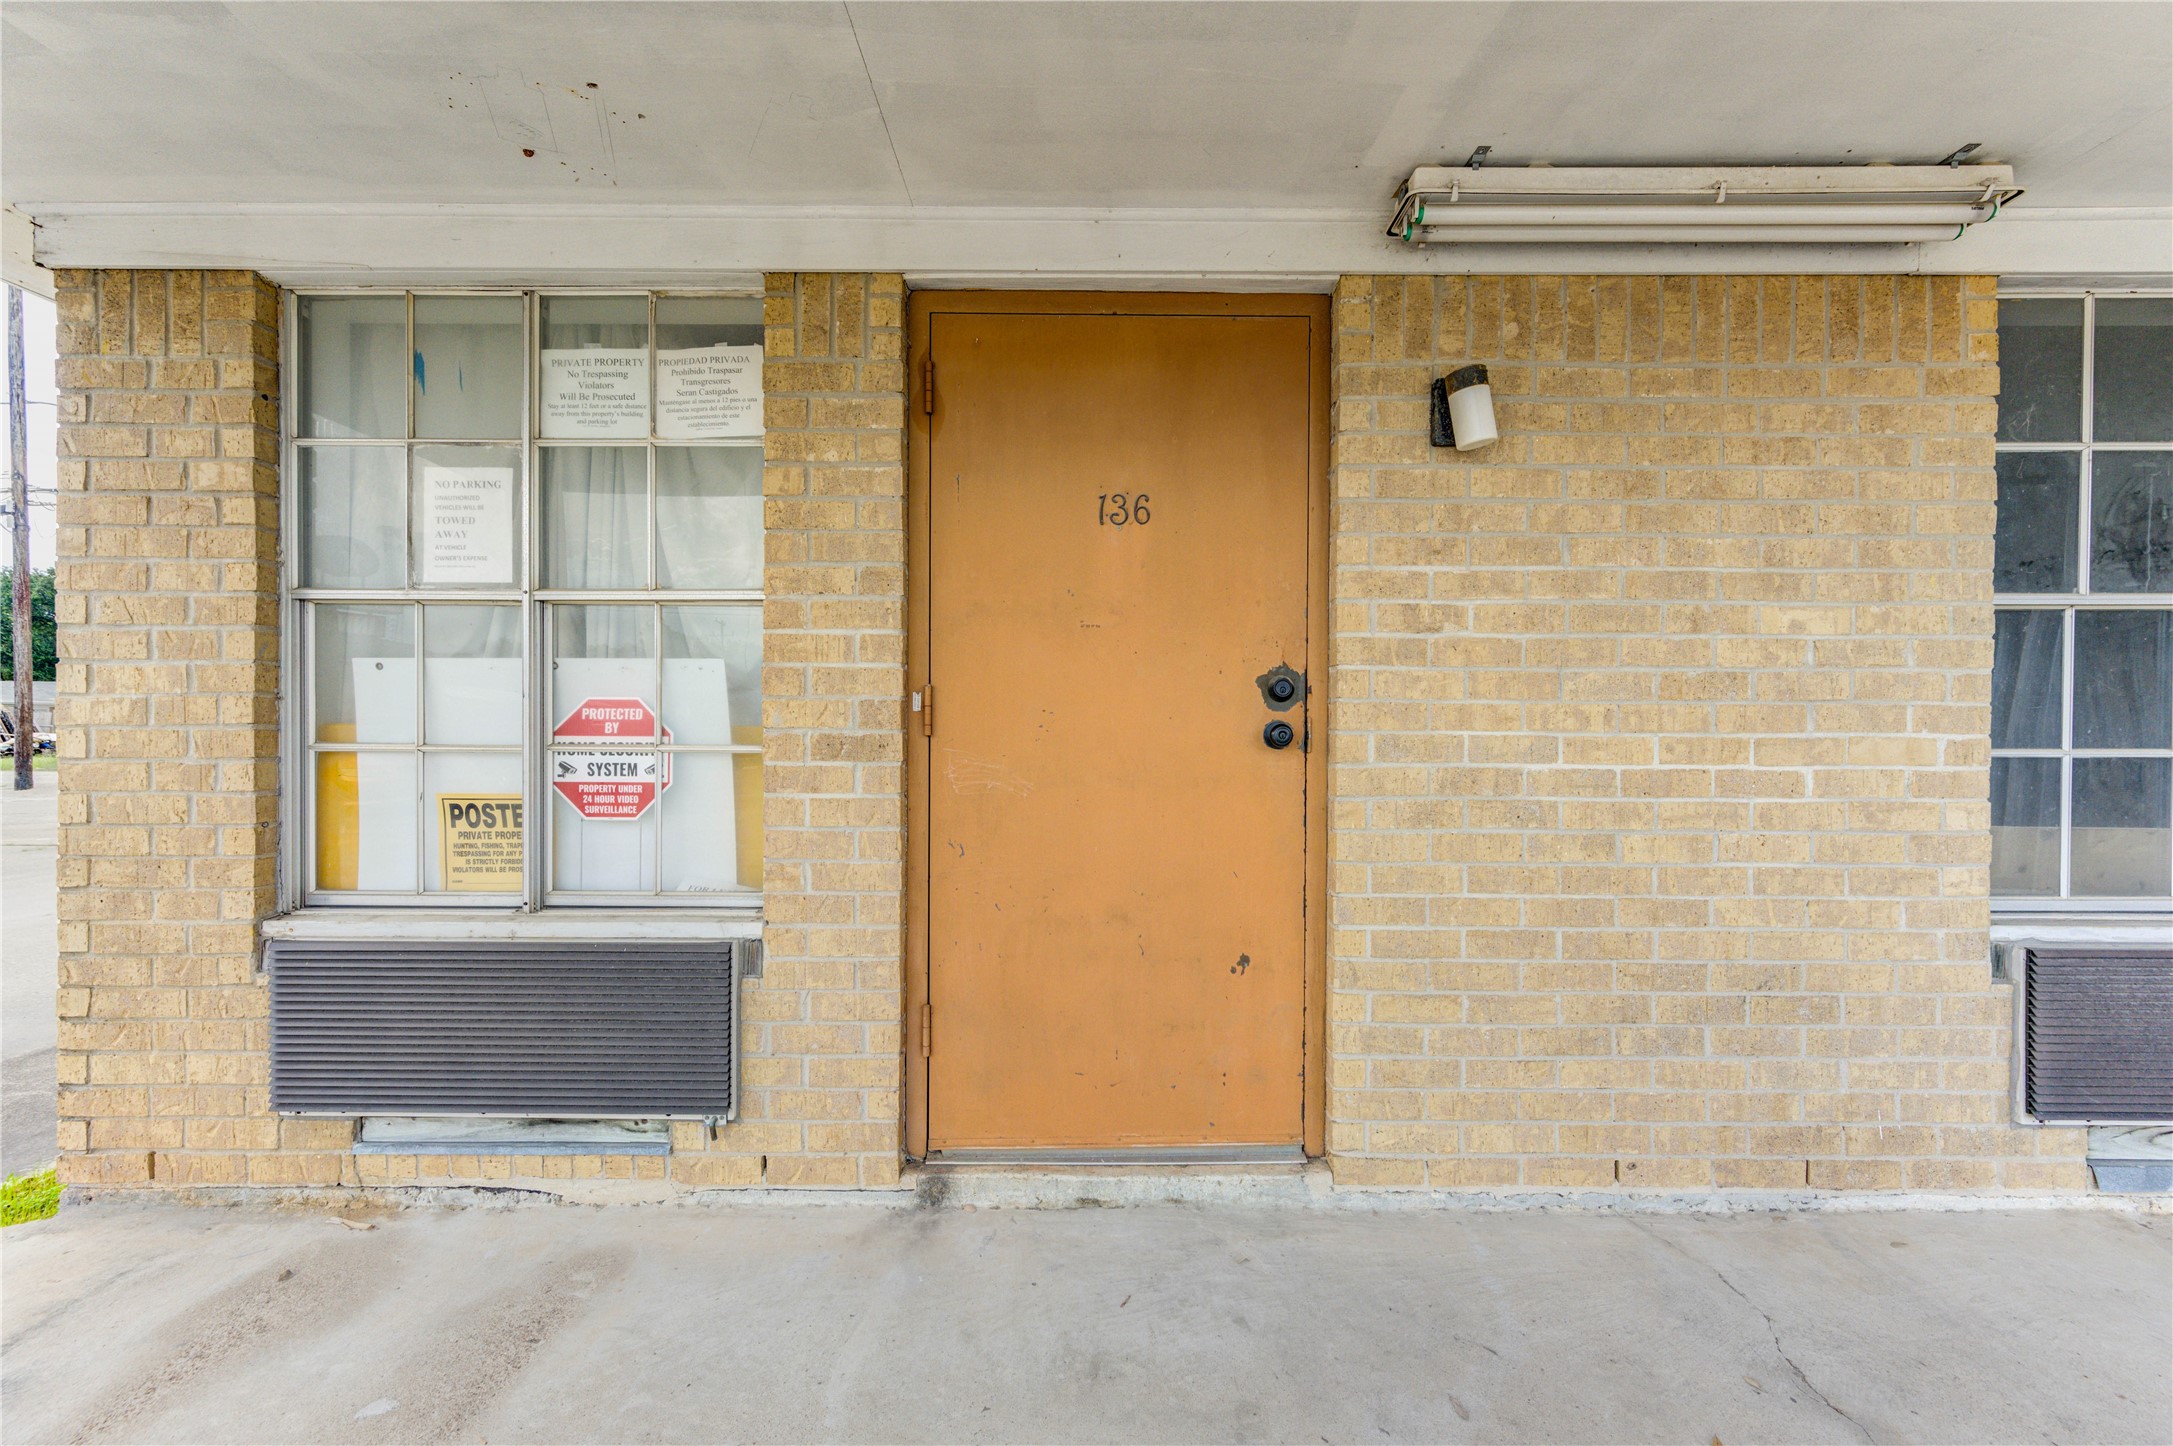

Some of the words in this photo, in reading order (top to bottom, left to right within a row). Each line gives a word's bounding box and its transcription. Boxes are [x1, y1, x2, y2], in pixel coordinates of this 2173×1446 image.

[551, 358, 592, 367] PRIVATE
[594, 358, 645, 367] PROPERTY
[658, 356, 708, 367] PROPIEDAD
[709, 355, 750, 364] PRIVADA
[567, 370, 579, 378] No
[582, 370, 628, 380] Trespassing
[671, 368, 705, 376] Prohibido
[707, 366, 743, 375] Traspasar
[578, 381, 614, 389] Violators
[681, 378, 731, 387] Transgresores
[698, 387, 738, 396] Castigados
[435, 480, 450, 489] NO
[453, 480, 501, 489] PARKING
[1098, 494, 1151, 525] 136
[435, 516, 476, 525] TOWED
[435, 530, 468, 538] AWAY
[581, 708, 643, 720] PROTECTED
[604, 722, 619, 734] BY
[587, 762, 638, 777] SYSTEM
[578, 784, 616, 793] PROPERTY
[618, 784, 643, 793] UNDER
[583, 795, 592, 804] 24
[594, 795, 615, 804] HOUR
[617, 795, 639, 804] VIDEO
[584, 805, 637, 814] SURVEILLANCE
[458, 831, 492, 840] PRIVATE
